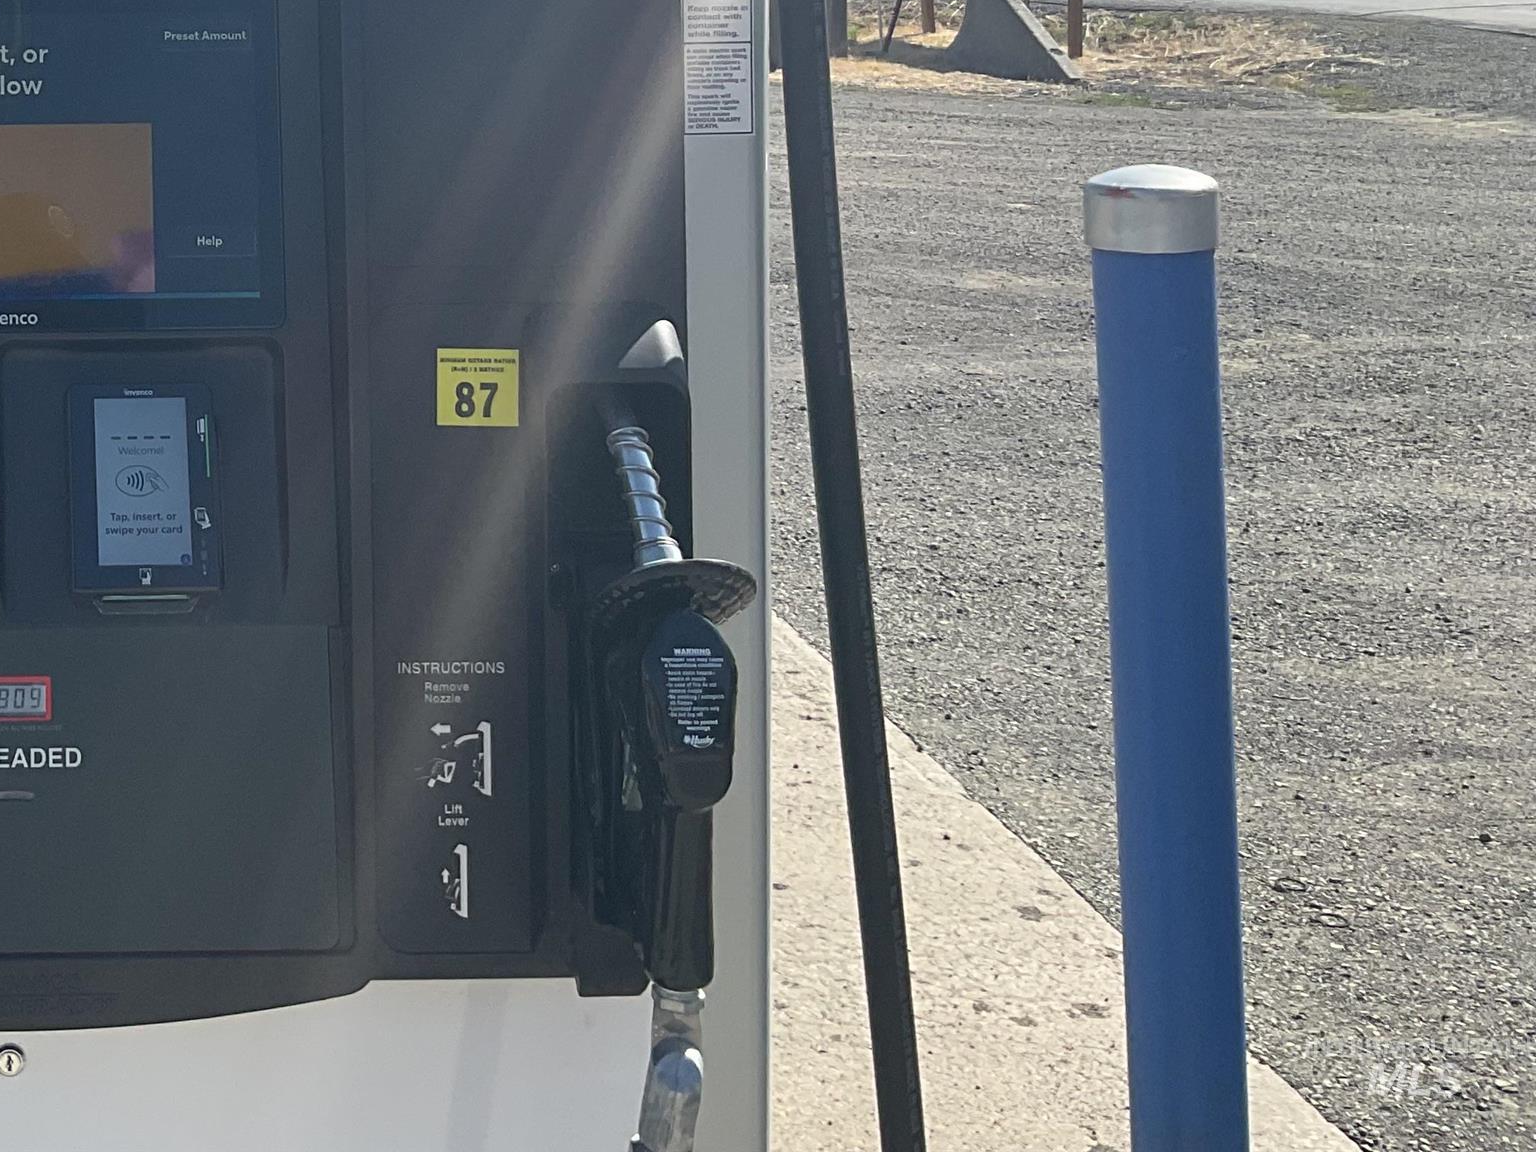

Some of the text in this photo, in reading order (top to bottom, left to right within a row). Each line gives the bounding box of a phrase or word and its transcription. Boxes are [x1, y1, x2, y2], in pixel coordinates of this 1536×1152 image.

[164, 30, 247, 41] Preset Amount
[22, 48, 49, 64] or
[197, 235, 223, 249] Help
[454, 381, 499, 418] 87
[110, 512, 177, 523] Tap, insert, or
[105, 524, 183, 536] swipe your card
[397, 661, 506, 674] INSTRUCTIONS
[424, 681, 470, 692] Remove
[424, 693, 462, 703] Nozzle
[444, 804, 463, 815] Lift
[438, 815, 470, 826] Lever
